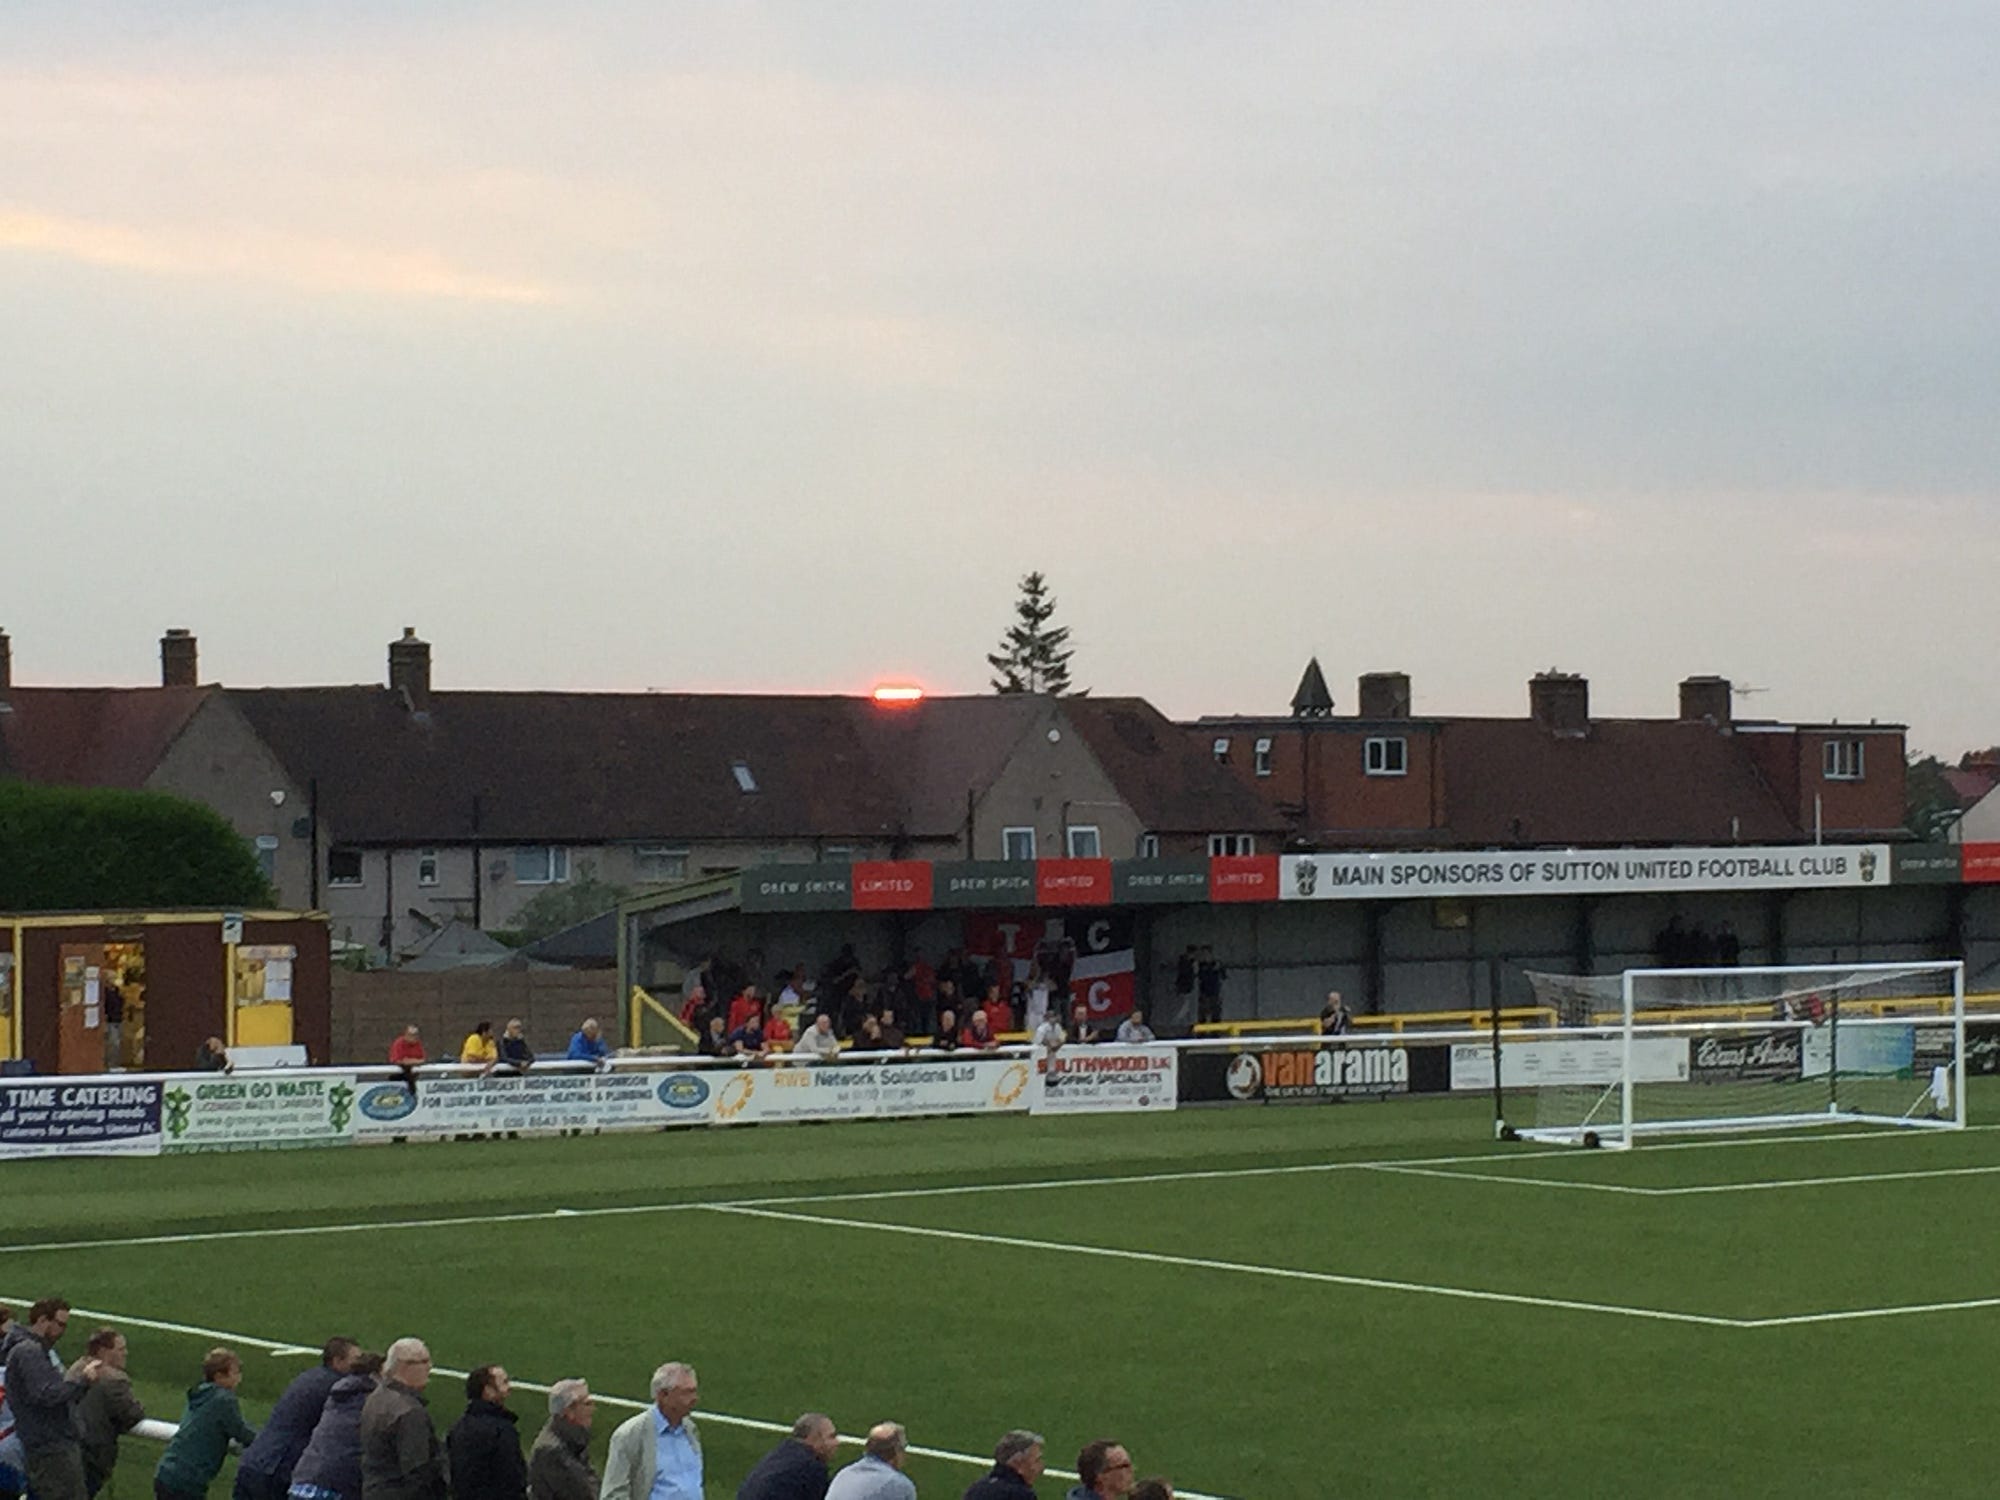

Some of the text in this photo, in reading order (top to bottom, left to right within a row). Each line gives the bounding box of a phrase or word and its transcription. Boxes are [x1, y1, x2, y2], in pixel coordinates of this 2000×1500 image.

[1128, 872, 1265, 887] DREW SMITH LIMITED
[1332, 856, 1847, 886] MAIN SPONSORS OF SUTTON UNITED FOOTBALL CLUB
[760, 879, 914, 895] DREW SMITH LIMITED
[950, 875, 1094, 891] DREW SMITH LIMITED
[998, 923, 1021, 953] T
[1087, 919, 1111, 951] C
[1088, 980, 1112, 1012] C
[814, 1069, 876, 1087] Network
[880, 1068, 947, 1085] Solutions
[951, 1066, 976, 1082] Ltd
[1262, 1048, 1409, 1086] vanarama
[195, 1080, 325, 1100] GREEN GO WASTE
[524, 1076, 591, 1090] INDEPENDENT
[6, 1085, 157, 1108] TIME CATERING
[422, 1096, 442, 1109] FOR
[444, 1095, 482, 1108] LUXURY
[51, 1106, 106, 1123] catering
